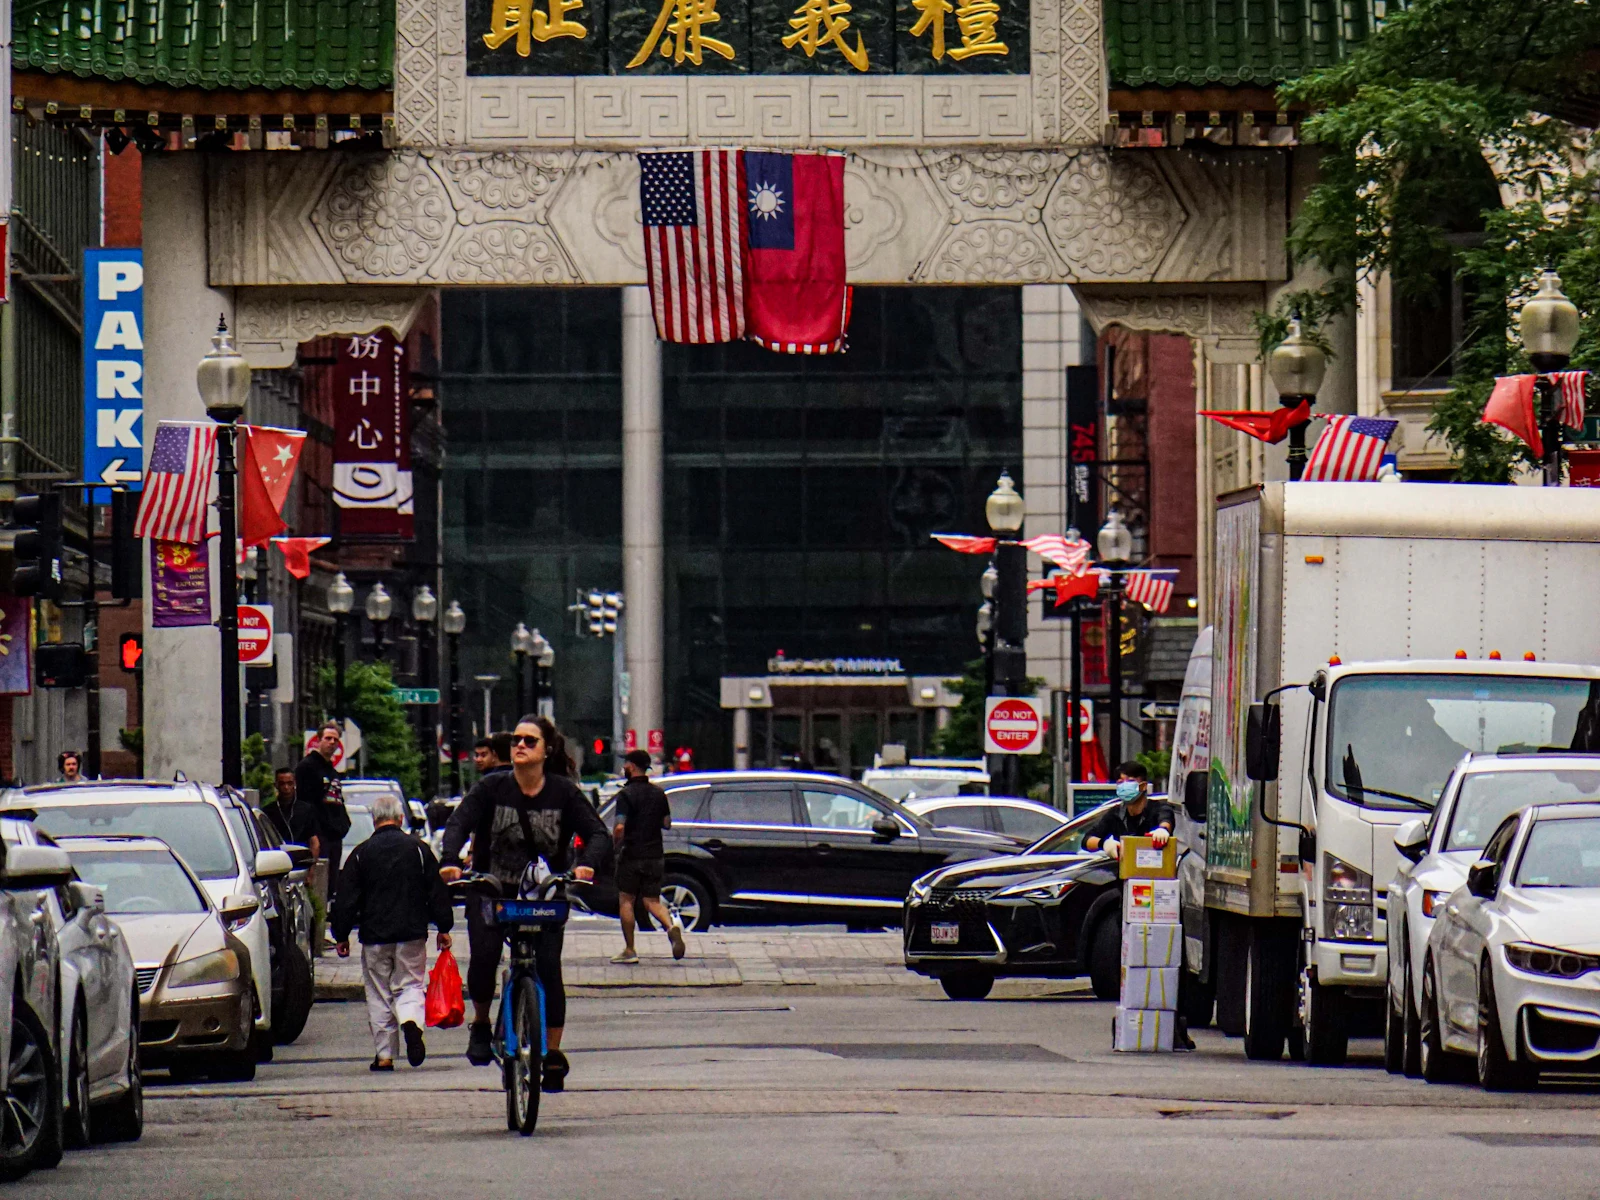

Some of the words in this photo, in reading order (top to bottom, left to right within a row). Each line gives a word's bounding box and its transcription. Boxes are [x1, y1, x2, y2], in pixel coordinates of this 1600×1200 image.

[95, 261, 143, 448] PARK
[1071, 422, 1096, 463] 745
[242, 617, 260, 627] NOT
[238, 641, 257, 651] NTER
[994, 710, 1010, 720] DO
[1012, 710, 1033, 720] NOT
[996, 731, 1029, 741] ENTER
